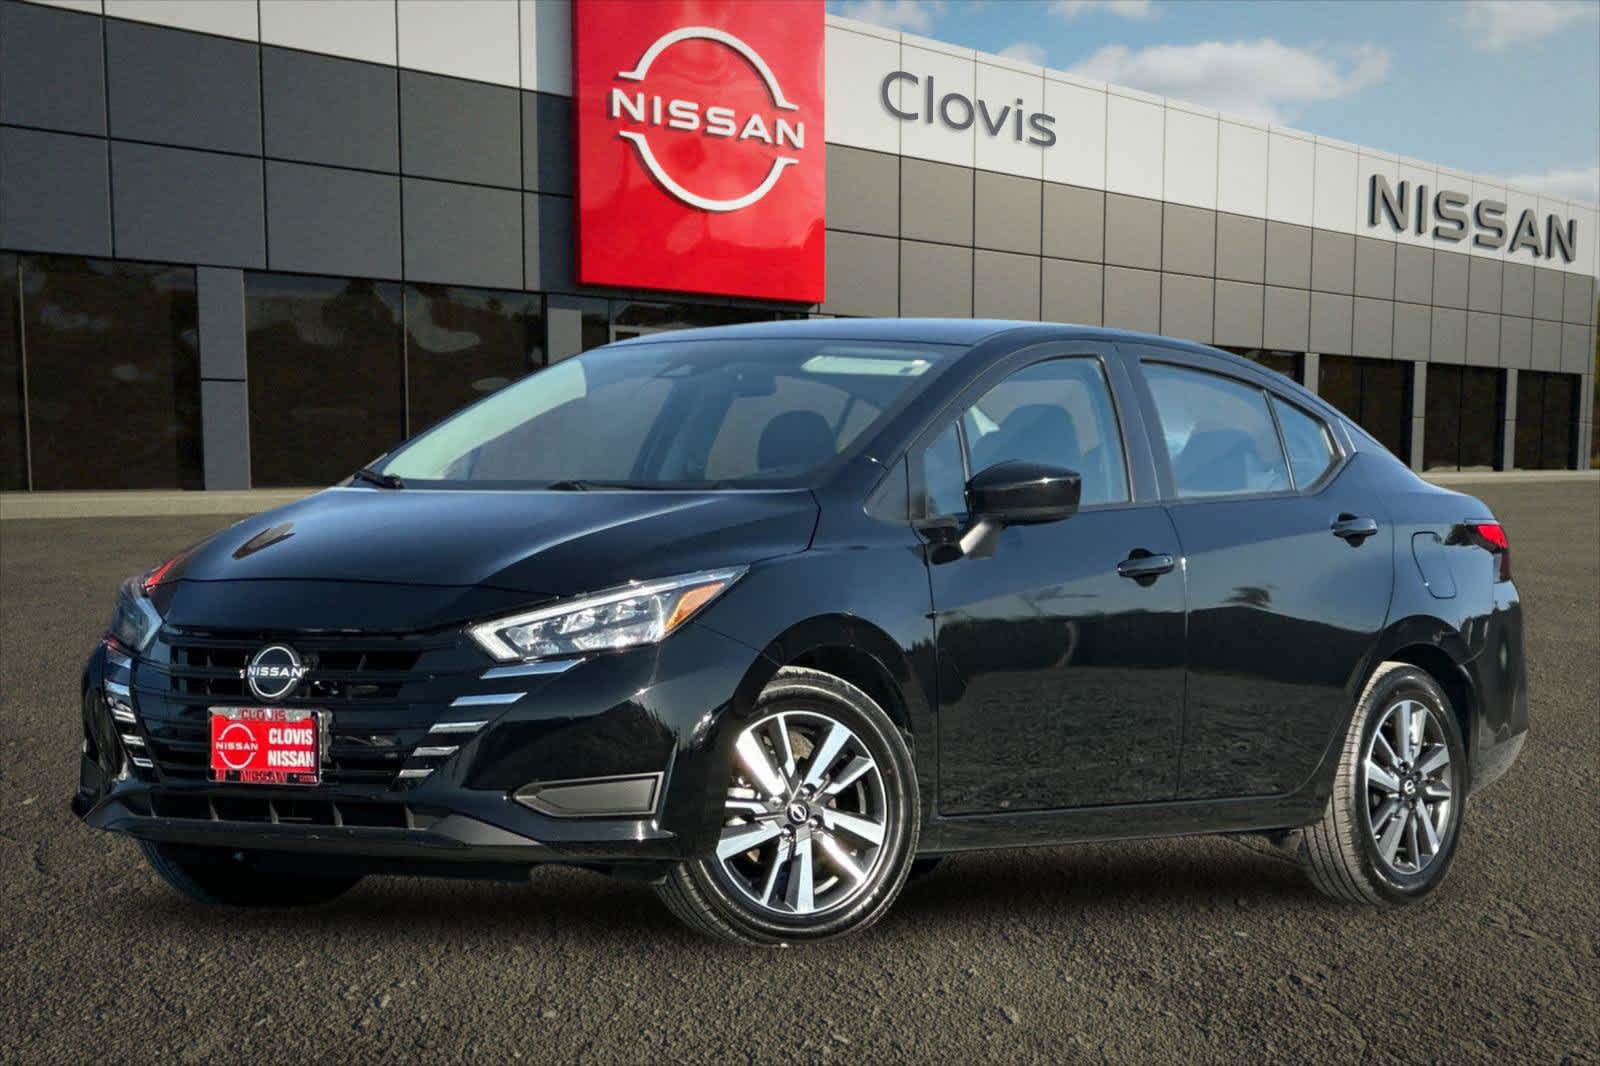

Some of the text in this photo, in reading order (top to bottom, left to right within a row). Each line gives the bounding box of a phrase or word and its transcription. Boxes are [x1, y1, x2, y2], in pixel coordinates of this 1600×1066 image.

[882, 71, 1058, 147] Clovis
[612, 88, 805, 149] NISSAN
[1368, 173, 1578, 263] NISSAN
[248, 666, 303, 678] NISSAN
[268, 727, 313, 745] CLOVIS
[216, 742, 258, 750] NISSAN
[267, 750, 315, 768] NISSAN
[239, 769, 288, 784] NISSAN
